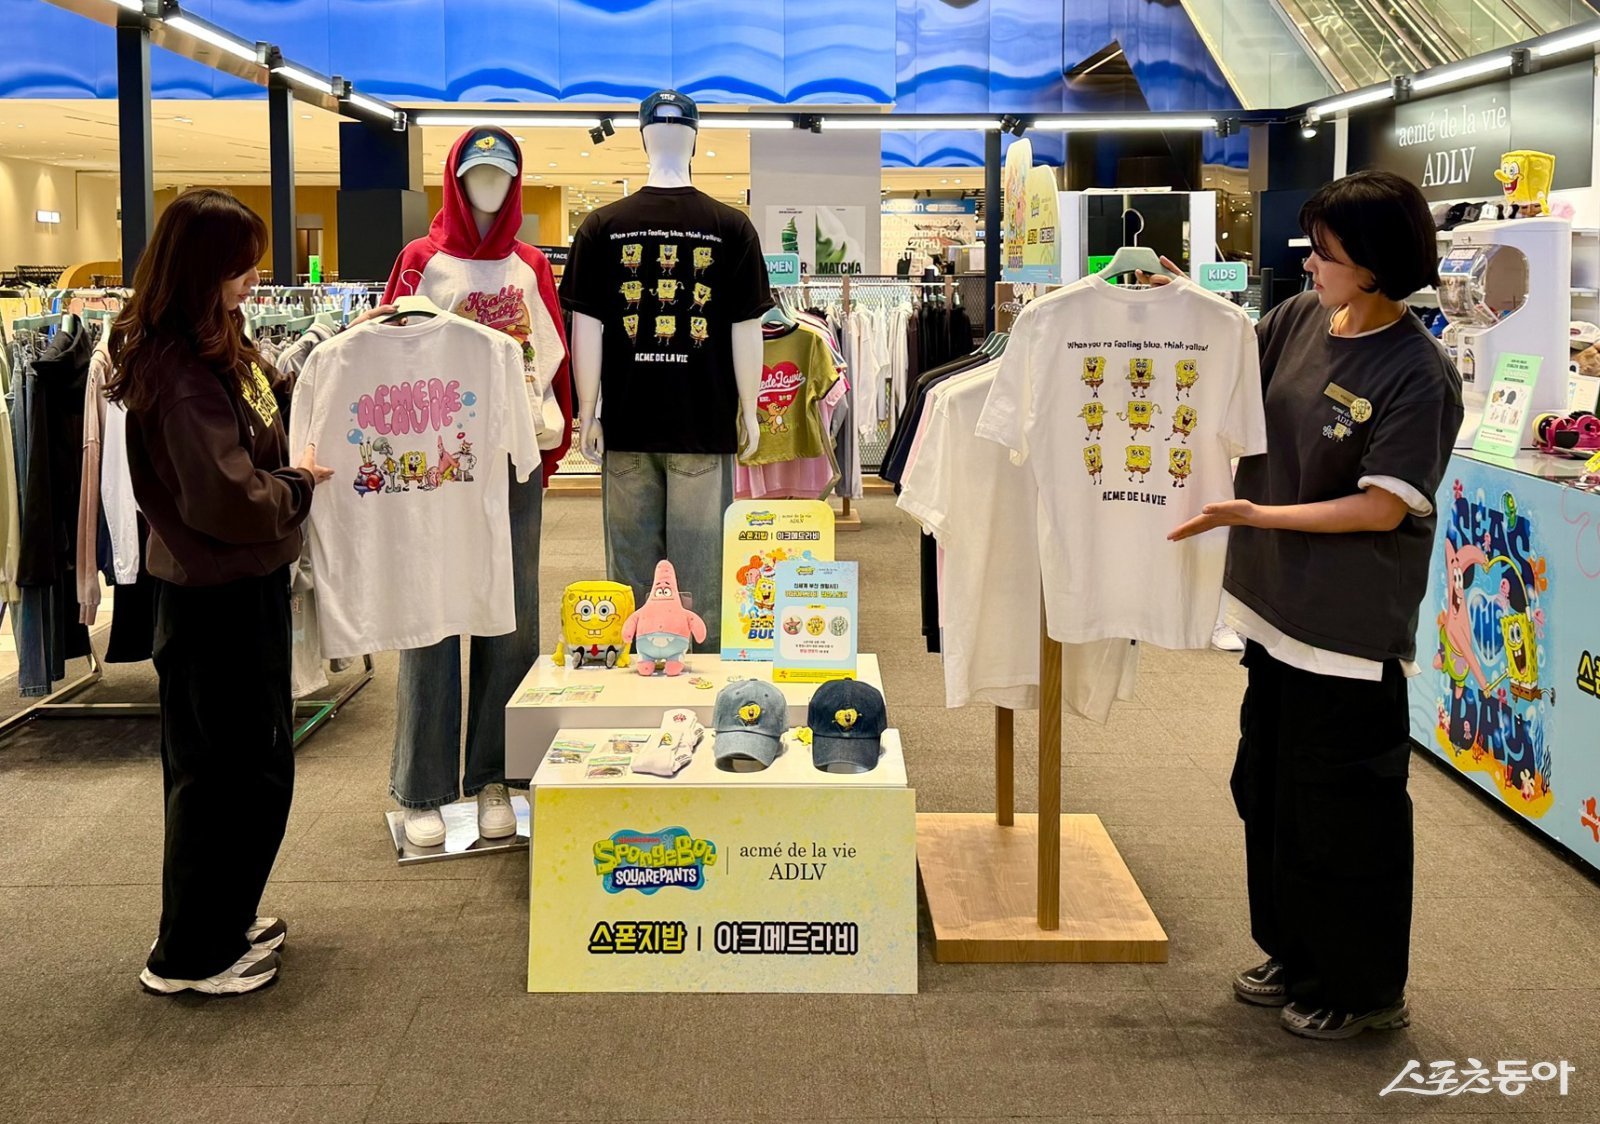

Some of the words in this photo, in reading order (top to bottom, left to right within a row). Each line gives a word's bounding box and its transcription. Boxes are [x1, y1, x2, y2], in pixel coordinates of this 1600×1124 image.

[1399, 111, 1436, 147] acmé
[1440, 108, 1457, 139] de
[1461, 104, 1477, 135] la
[1481, 97, 1507, 131] vie
[1421, 146, 1477, 188] ADLV
[819, 262, 862, 274] MATCHA
[1208, 268, 1237, 281] KIDS
[465, 284, 524, 312] Krabby
[1067, 341, 1088, 350] When
[1114, 340, 1142, 350] feeling
[1164, 341, 1184, 350] think
[634, 352, 655, 362] ACME
[655, 353, 665, 362] DE
[665, 353, 675, 362] LA
[676, 353, 689, 363] VIE
[1102, 491, 1126, 501] ACME
[1127, 491, 1139, 502] DE
[1140, 492, 1151, 503] LA
[1151, 494, 1167, 506] VIE
[738, 530, 769, 541] 스폰지밥
[776, 530, 820, 541] 아크메드라비
[1448, 497, 1536, 614] SEAS
[1473, 596, 1504, 662] THE
[1449, 684, 1536, 790] DAY
[740, 842, 782, 858] acmé
[788, 842, 807, 858] de
[812, 842, 827, 858] la
[833, 843, 857, 858] vie
[615, 867, 698, 887] SQUAREPANTS
[769, 862, 827, 881] ADLV
[588, 921, 688, 954] 스폰지밥
[714, 921, 858, 955] 아크메드라비
